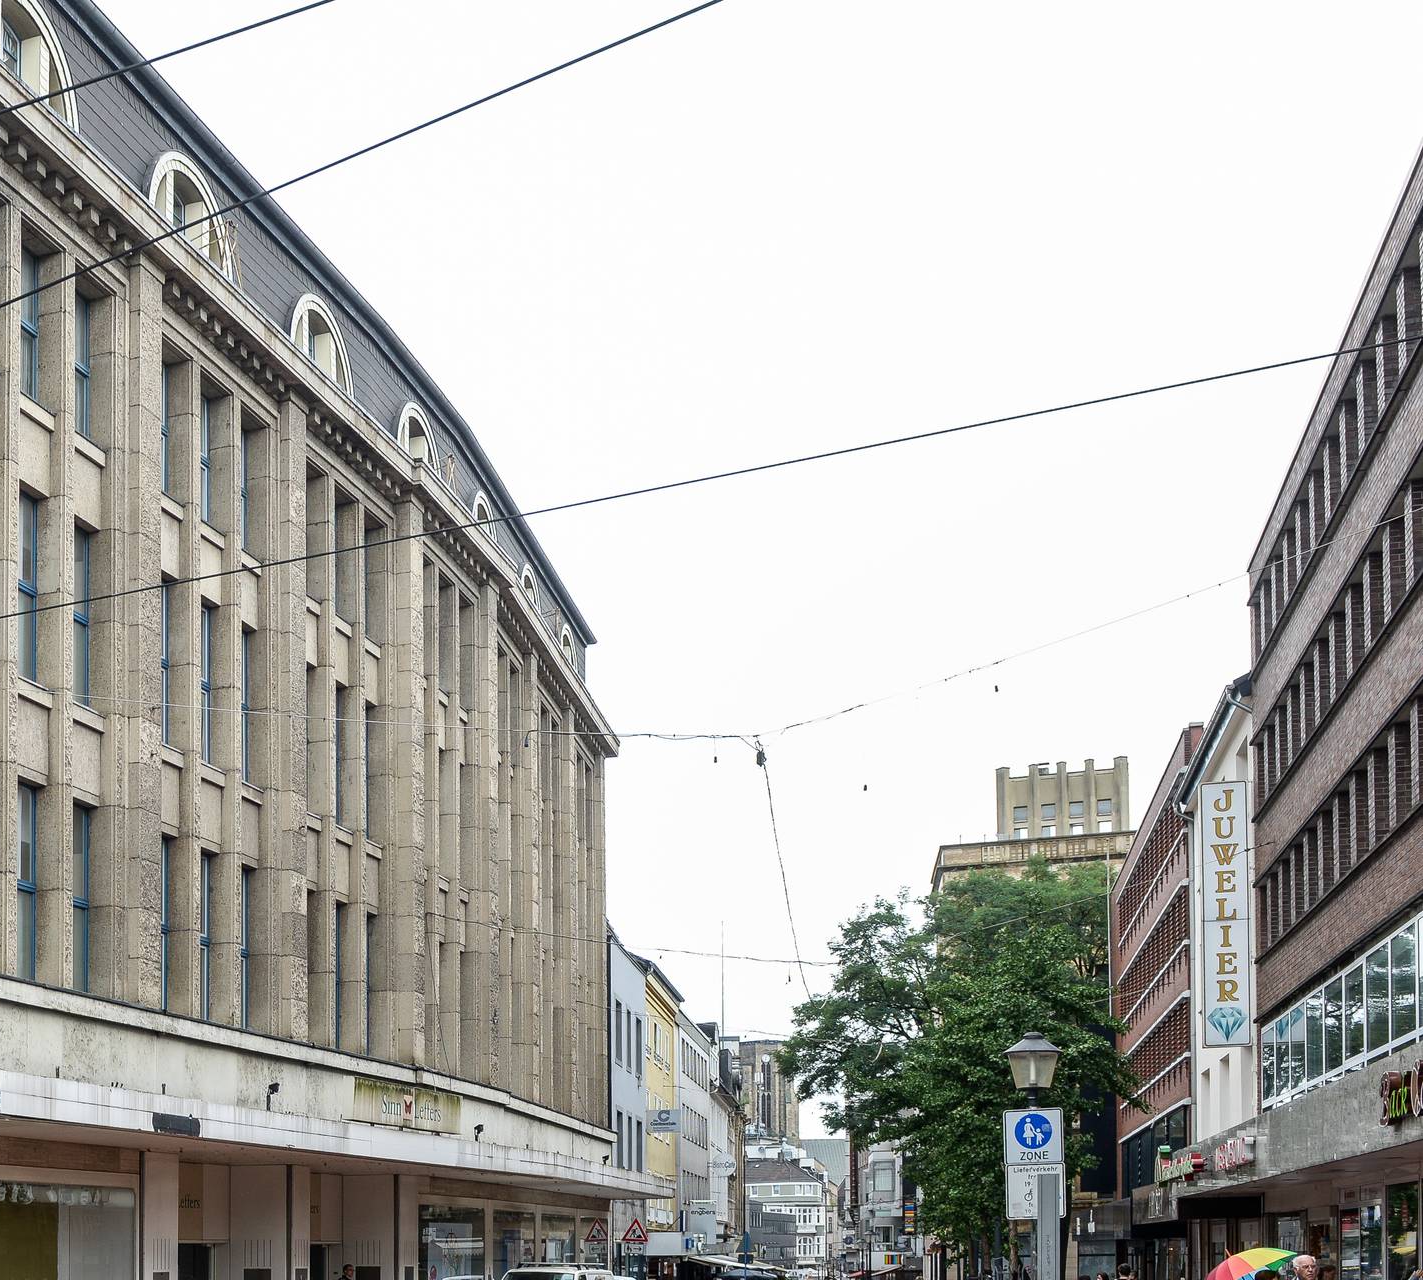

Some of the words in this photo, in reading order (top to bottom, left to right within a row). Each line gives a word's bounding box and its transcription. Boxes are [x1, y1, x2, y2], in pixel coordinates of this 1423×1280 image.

[1211, 789, 1239, 1002] JUWELIER
[381, 1094, 402, 1116] Sinn
[414, 1098, 442, 1122] Leffers
[1020, 1150, 1049, 1161] ZONE
[1013, 1166, 1058, 1174] Lieferverkehr
[178, 1192, 201, 1209] effers
[690, 1208, 716, 1216] engbers
